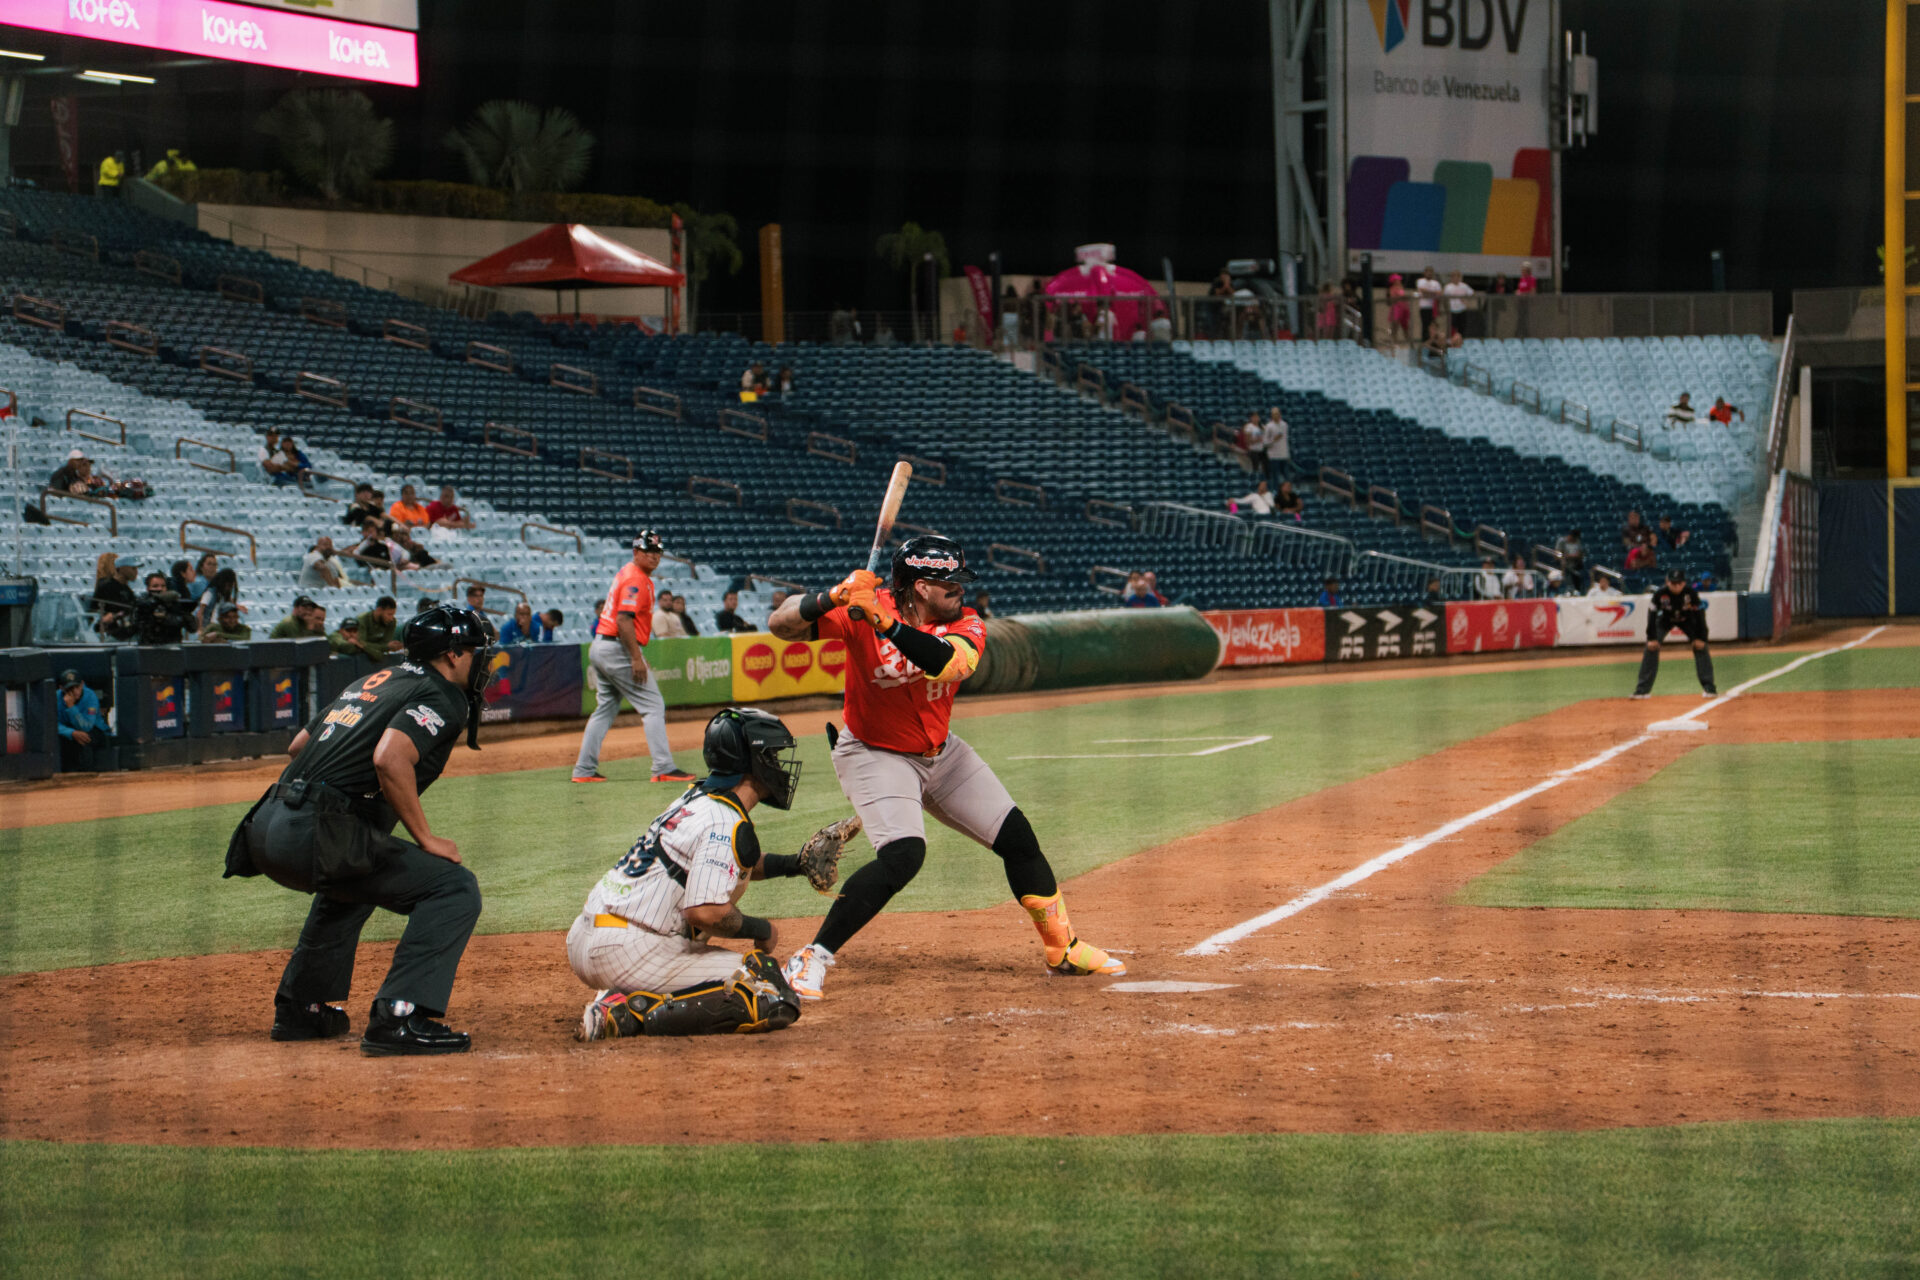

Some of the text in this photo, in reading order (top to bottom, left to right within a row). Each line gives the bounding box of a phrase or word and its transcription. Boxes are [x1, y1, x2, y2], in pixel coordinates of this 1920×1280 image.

[202, 9, 268, 51] kotex
[1422, 0, 1528, 53] BDV
[328, 29, 390, 69] kotex
[1374, 70, 1520, 103] Banco de Venezuela
